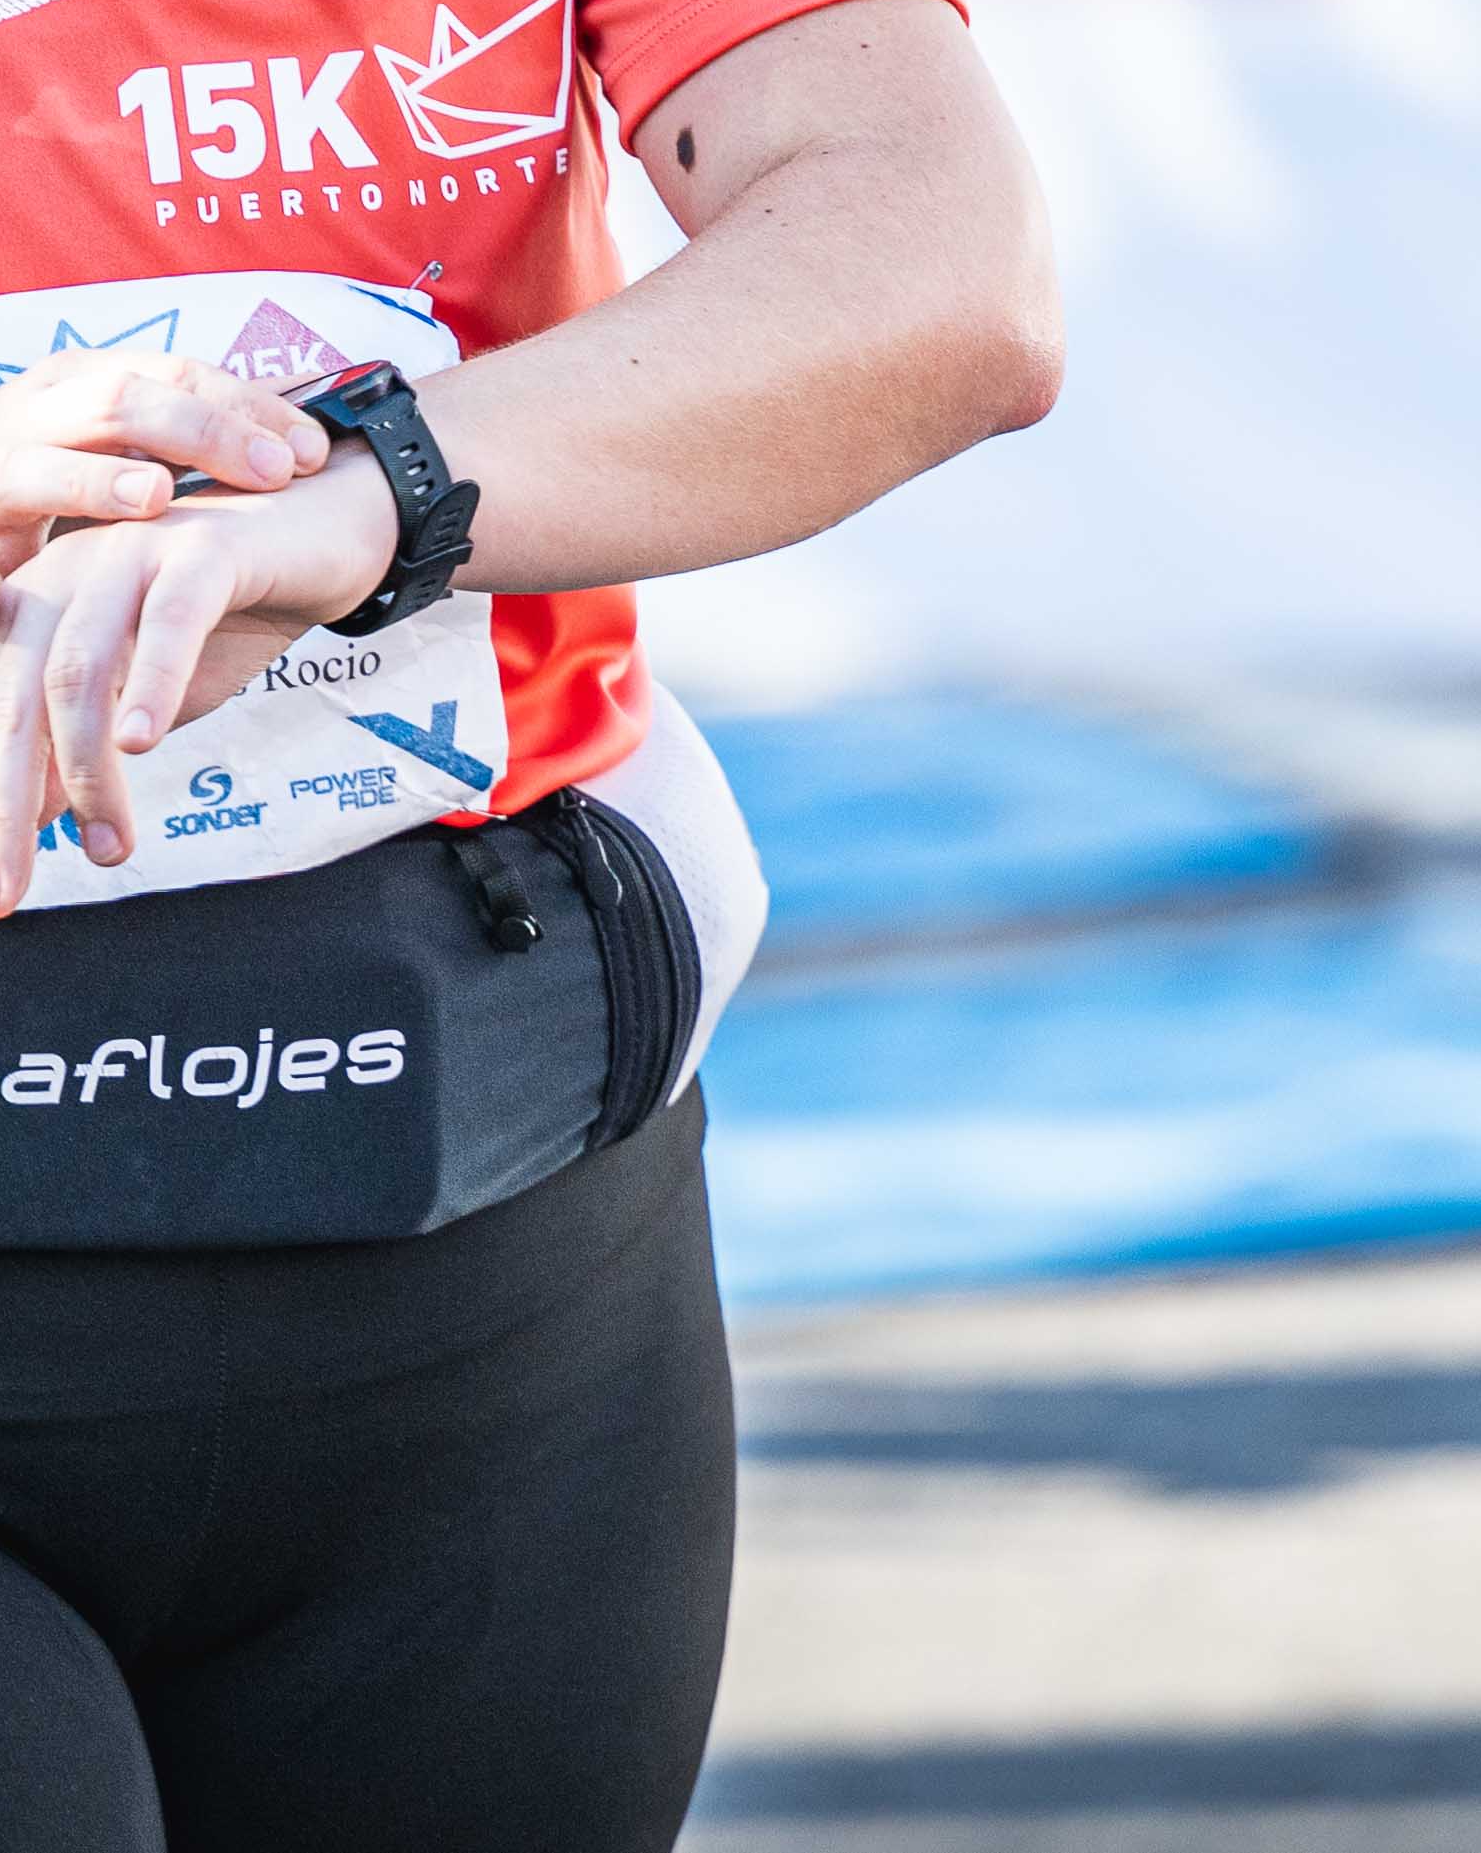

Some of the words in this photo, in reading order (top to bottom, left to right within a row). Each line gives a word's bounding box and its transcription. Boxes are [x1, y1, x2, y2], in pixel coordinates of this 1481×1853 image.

[117, 50, 380, 185] 15K
[262, 642, 382, 692] Rocio
[289, 766, 397, 799] POWER
